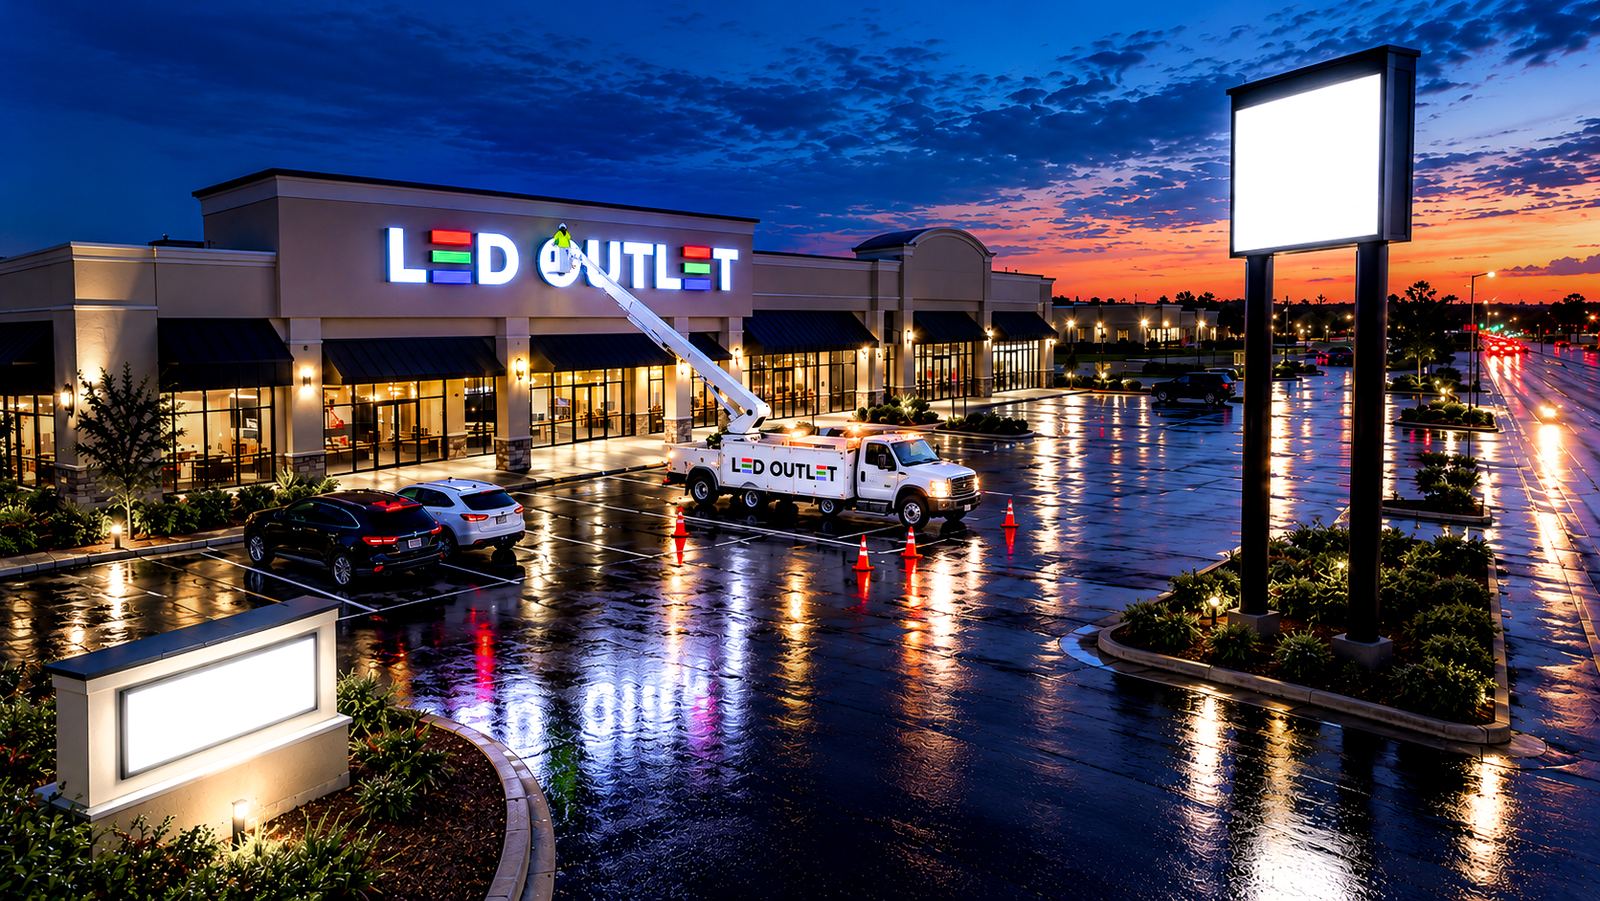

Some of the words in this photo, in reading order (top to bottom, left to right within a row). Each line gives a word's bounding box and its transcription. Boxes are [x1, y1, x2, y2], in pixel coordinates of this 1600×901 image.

[386, 227, 519, 285] LED
[537, 238, 738, 291] OUTLET
[732, 457, 764, 474] LED
[769, 461, 837, 482] OUTLET
